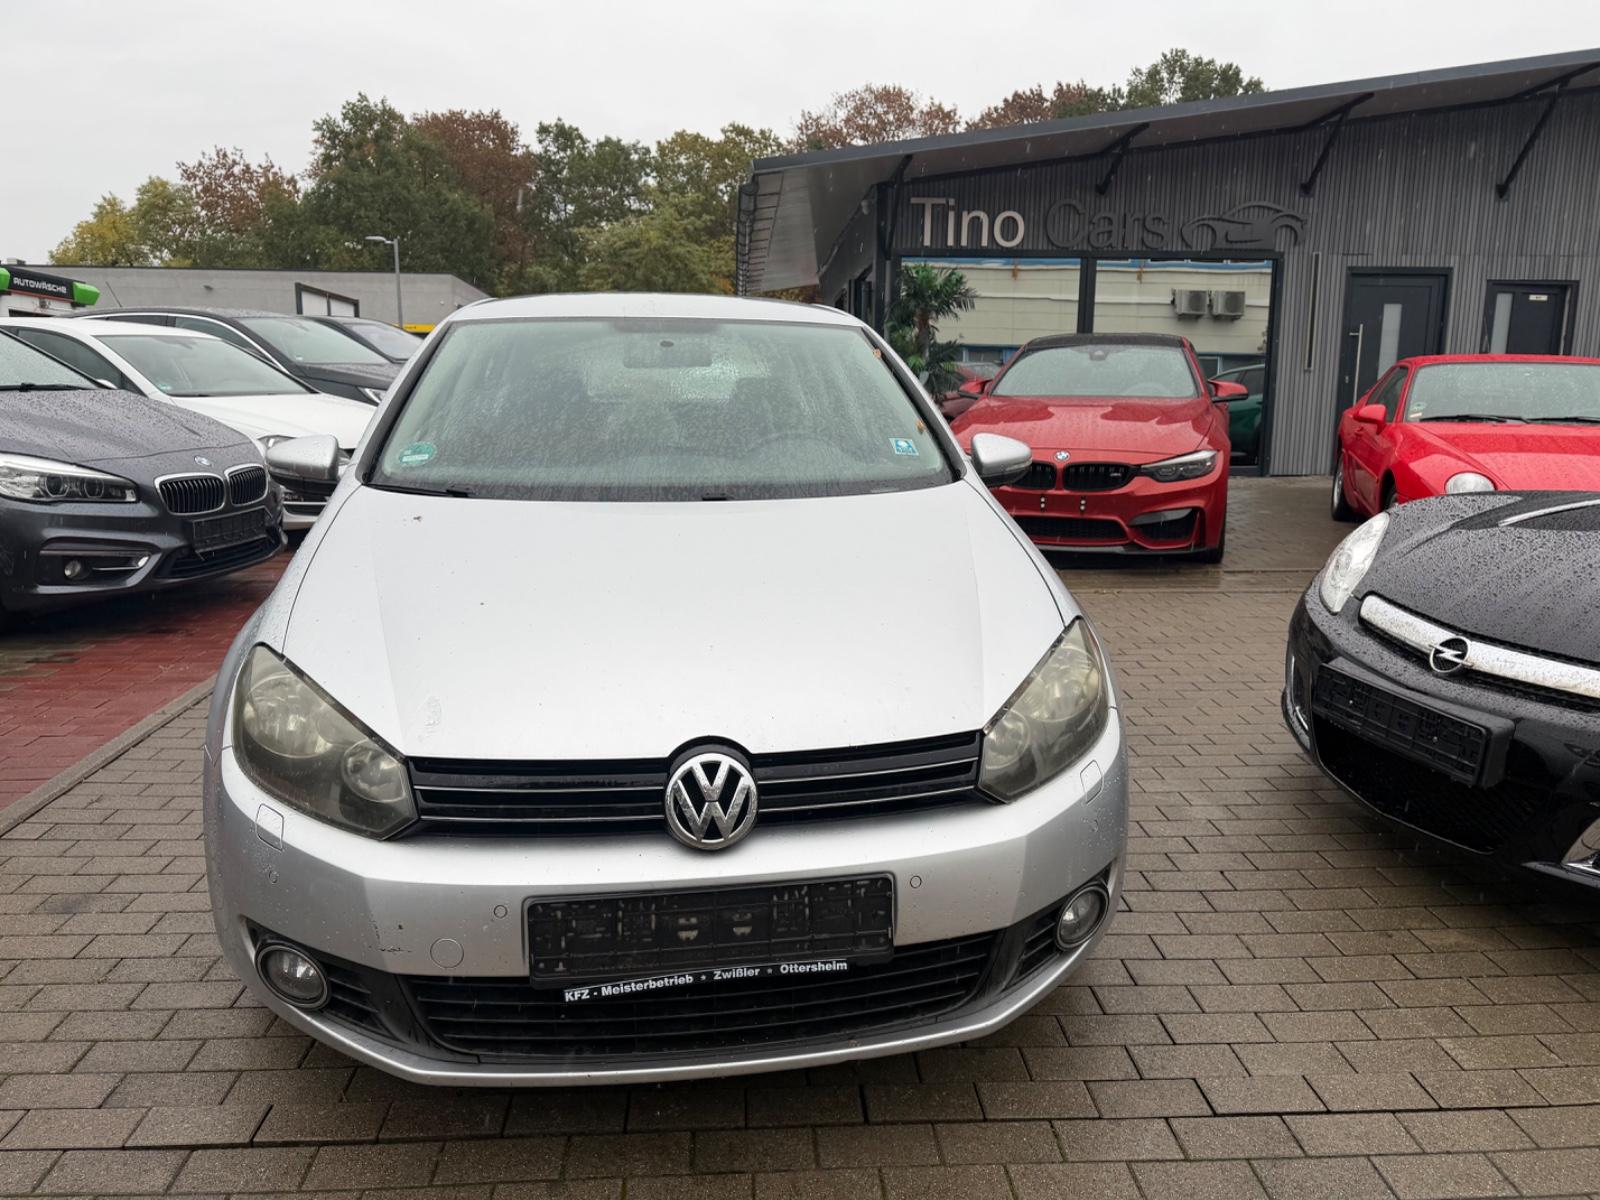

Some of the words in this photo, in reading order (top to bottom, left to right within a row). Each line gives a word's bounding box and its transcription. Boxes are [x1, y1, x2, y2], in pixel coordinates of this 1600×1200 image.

[910, 197, 1026, 248] Tino
[1045, 201, 1169, 249] Cars
[565, 990, 590, 1002] KFZ
[601, 974, 694, 996] Meisterbetrieb
[713, 967, 760, 980] Zwißler
[780, 961, 847, 974] Ottersheim
